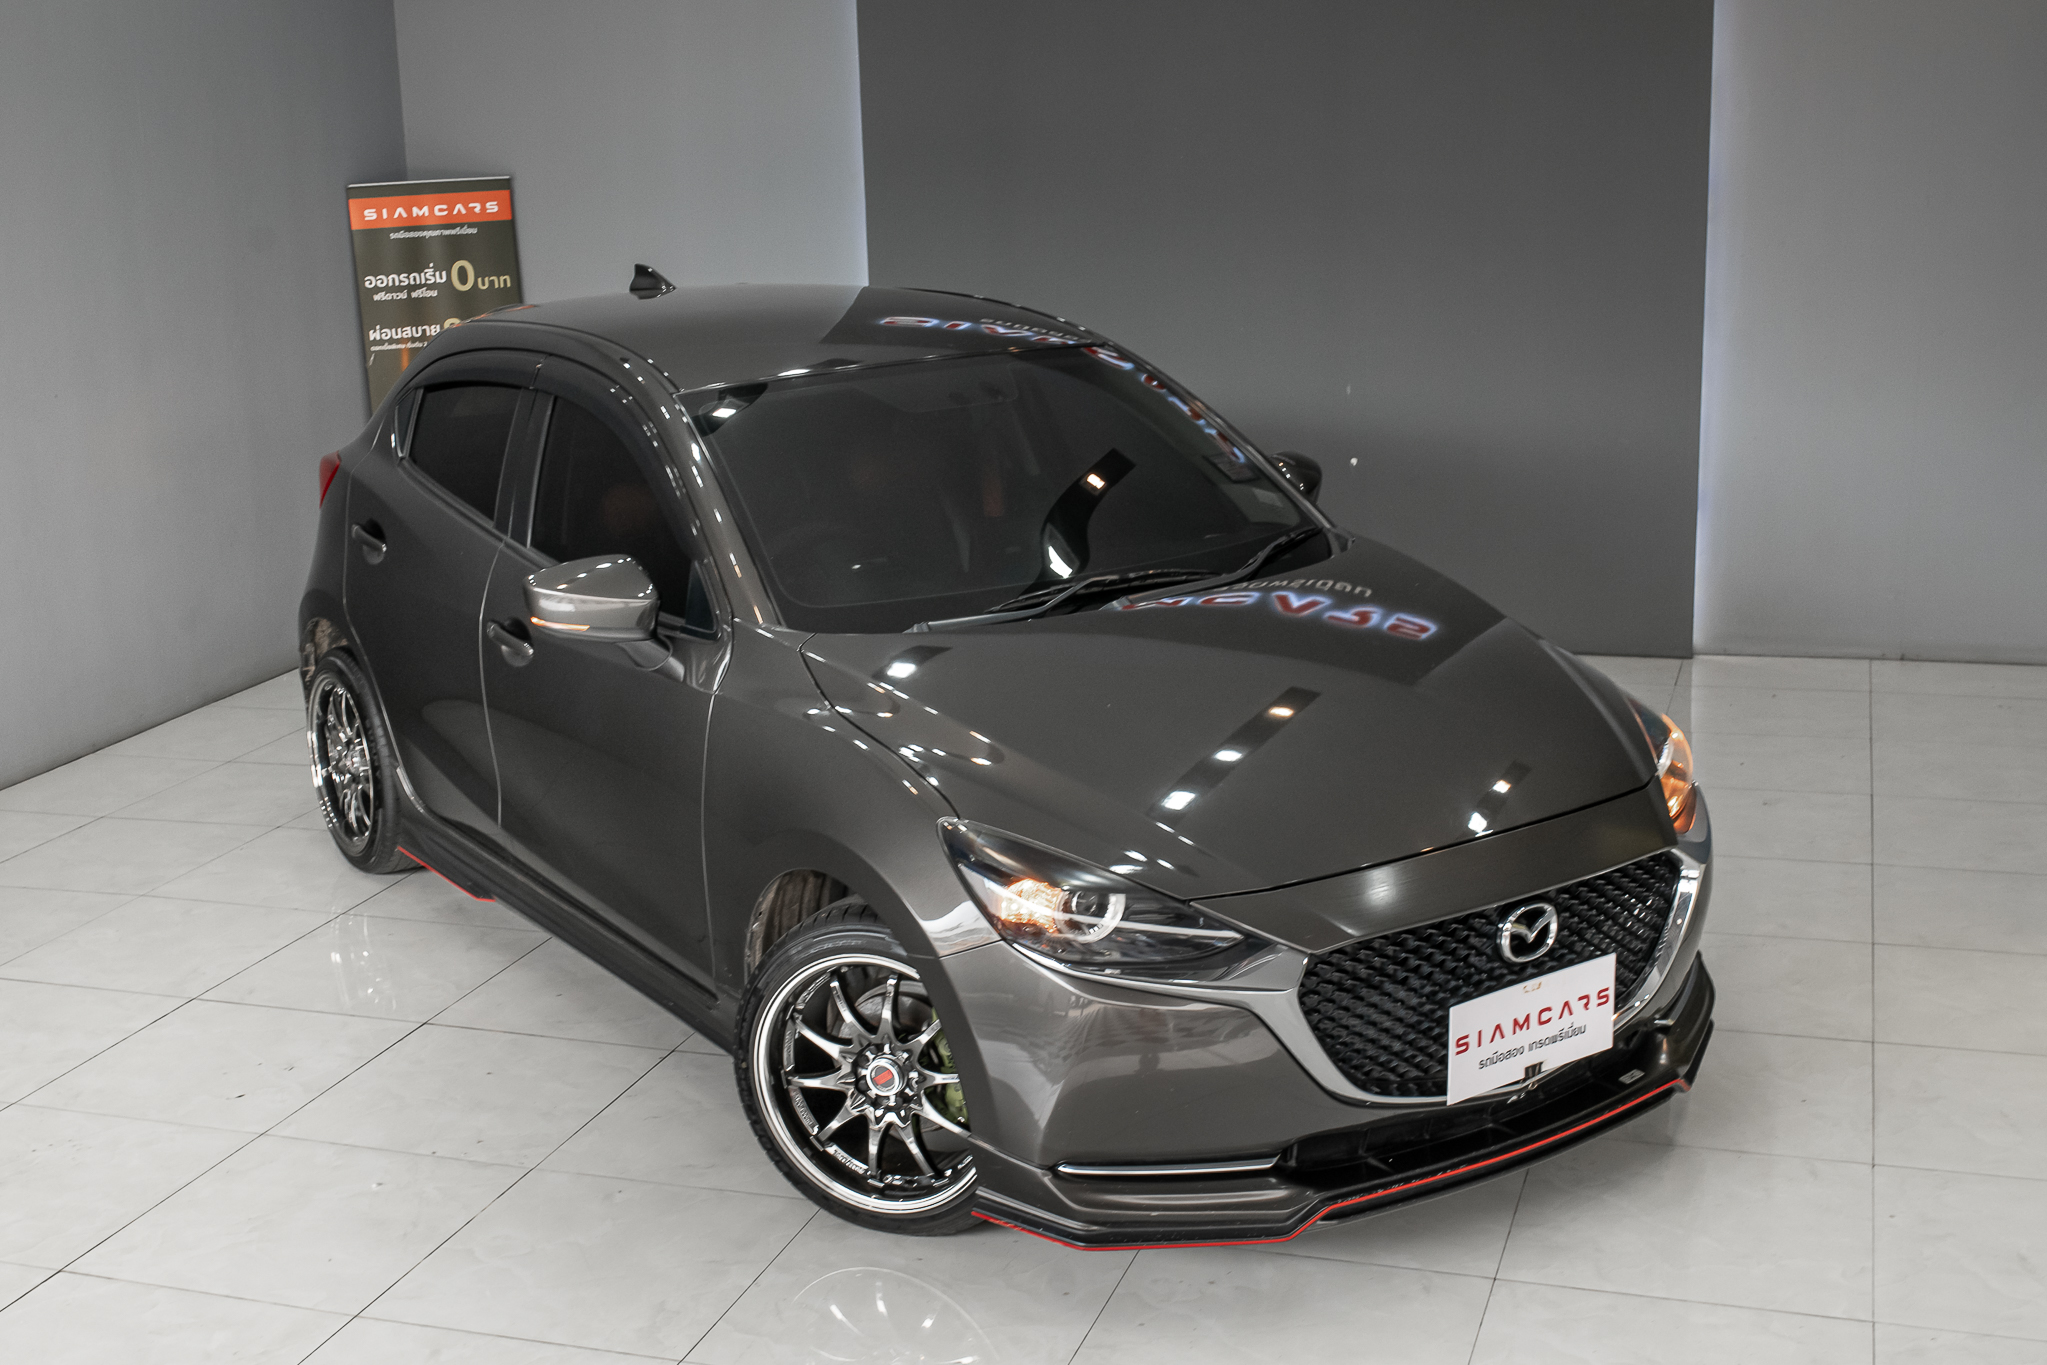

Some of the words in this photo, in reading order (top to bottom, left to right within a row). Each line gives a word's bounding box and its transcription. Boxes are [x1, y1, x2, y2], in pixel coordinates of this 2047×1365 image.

[364, 202, 499, 220] SIAMCARS
[364, 263, 447, 288] ออกรถเริ่ม
[451, 260, 475, 291] 0
[477, 275, 511, 290] บาท
[368, 324, 441, 341] ผ่อนสบาย
[1455, 987, 1610, 1056] SIAMCARS
[1478, 1045, 1525, 1070] รถมือสอง
